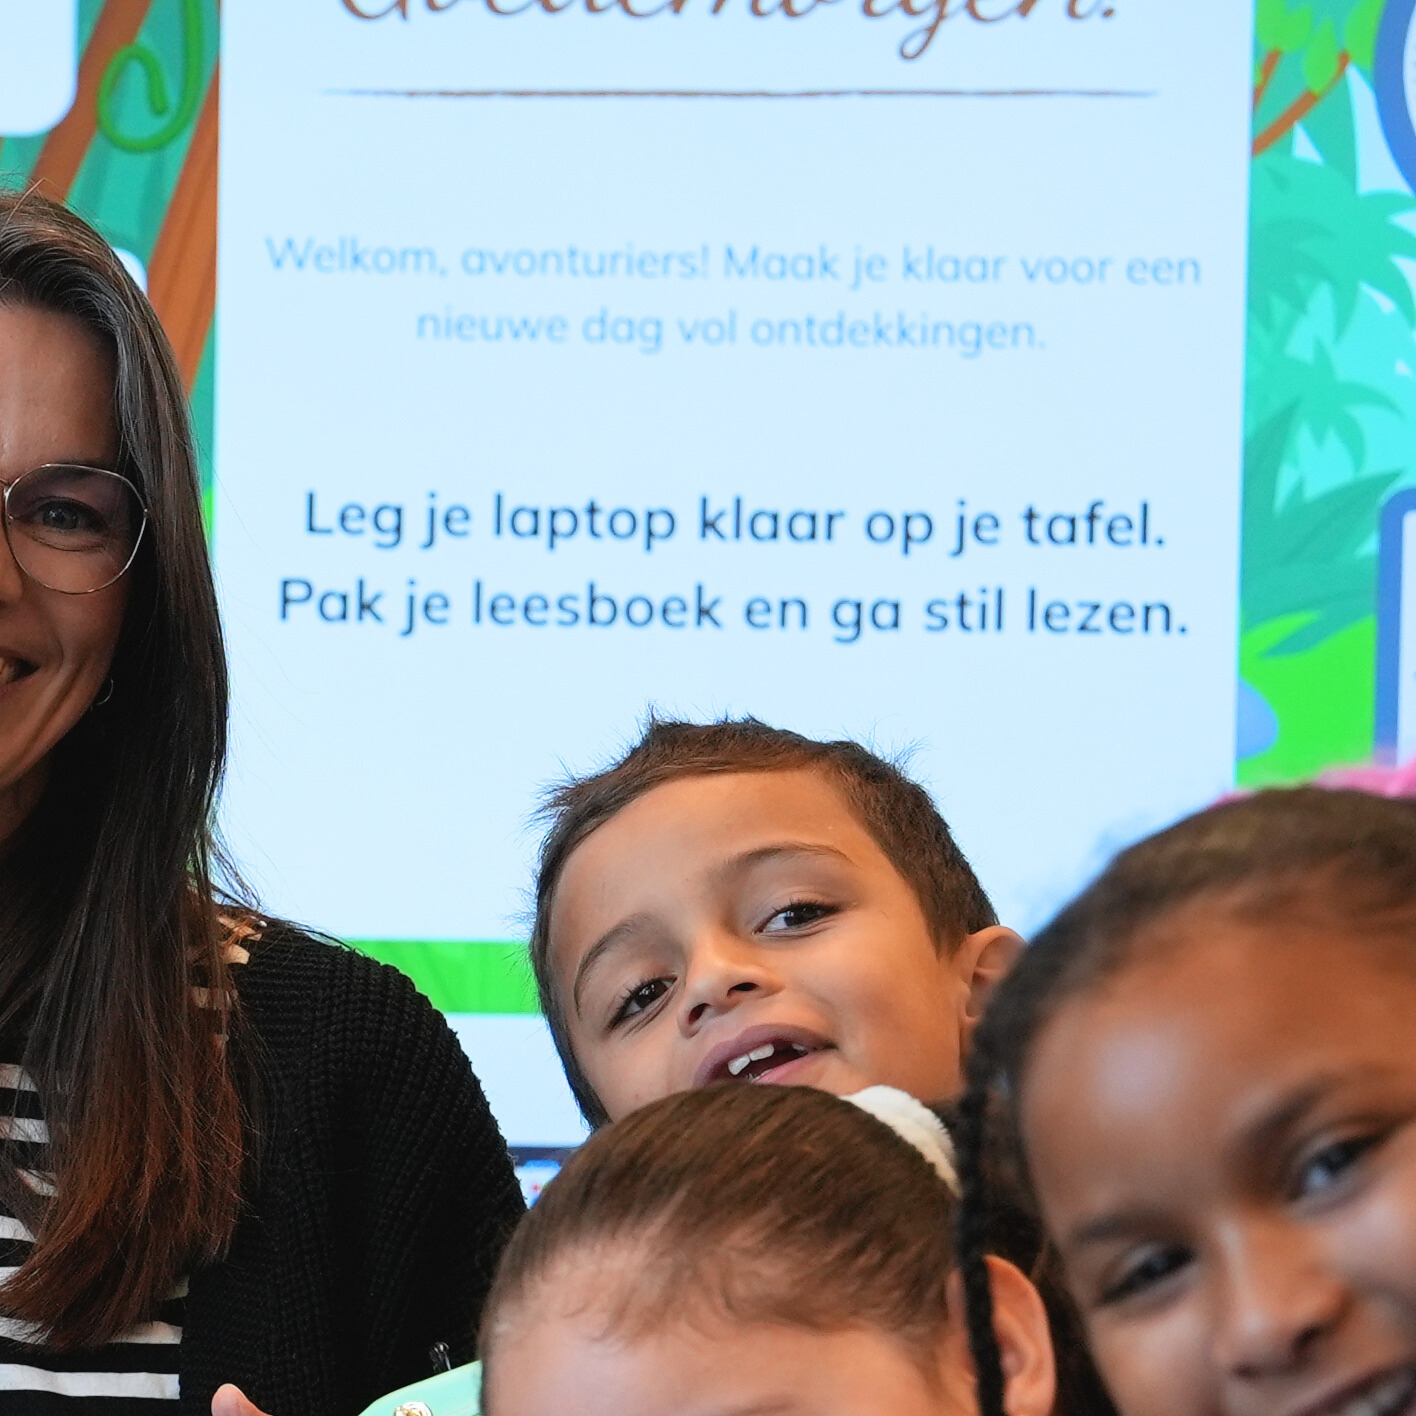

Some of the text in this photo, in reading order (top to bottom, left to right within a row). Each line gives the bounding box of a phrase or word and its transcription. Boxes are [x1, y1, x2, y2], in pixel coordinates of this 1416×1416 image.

[265, 237, 1202, 291] Welkom, avonturiers! Maak je klaar voor een
[416, 308, 1046, 359] nieuwe dag vol ontdekkingen.
[304, 490, 1166, 559] Leg je laptop klaar op je tafel.
[278, 577, 1189, 646] Pak je leesboek en ga stil lezen.
